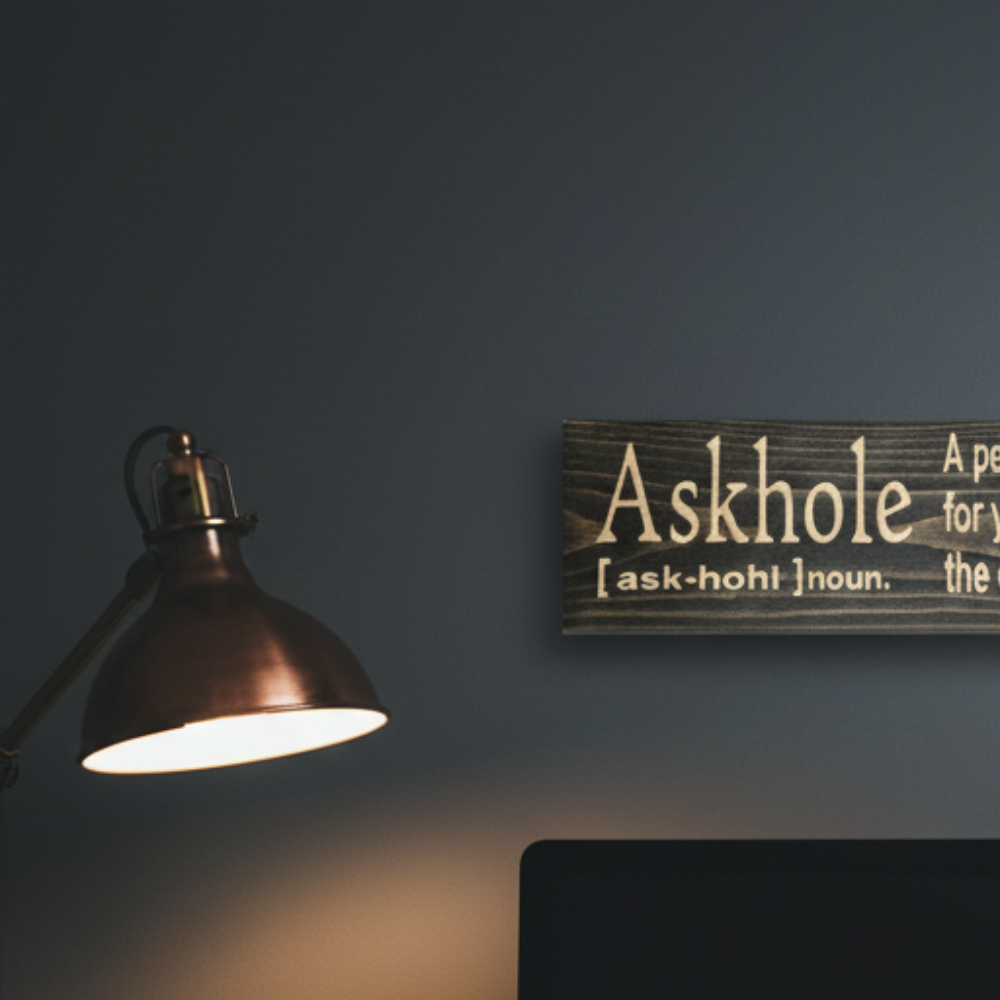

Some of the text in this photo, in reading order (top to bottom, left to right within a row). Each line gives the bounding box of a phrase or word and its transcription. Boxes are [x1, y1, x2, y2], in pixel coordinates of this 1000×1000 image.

[942, 432, 964, 474] A
[596, 434, 913, 545] Askhole
[943, 490, 985, 532] for
[944, 551, 990, 595] the
